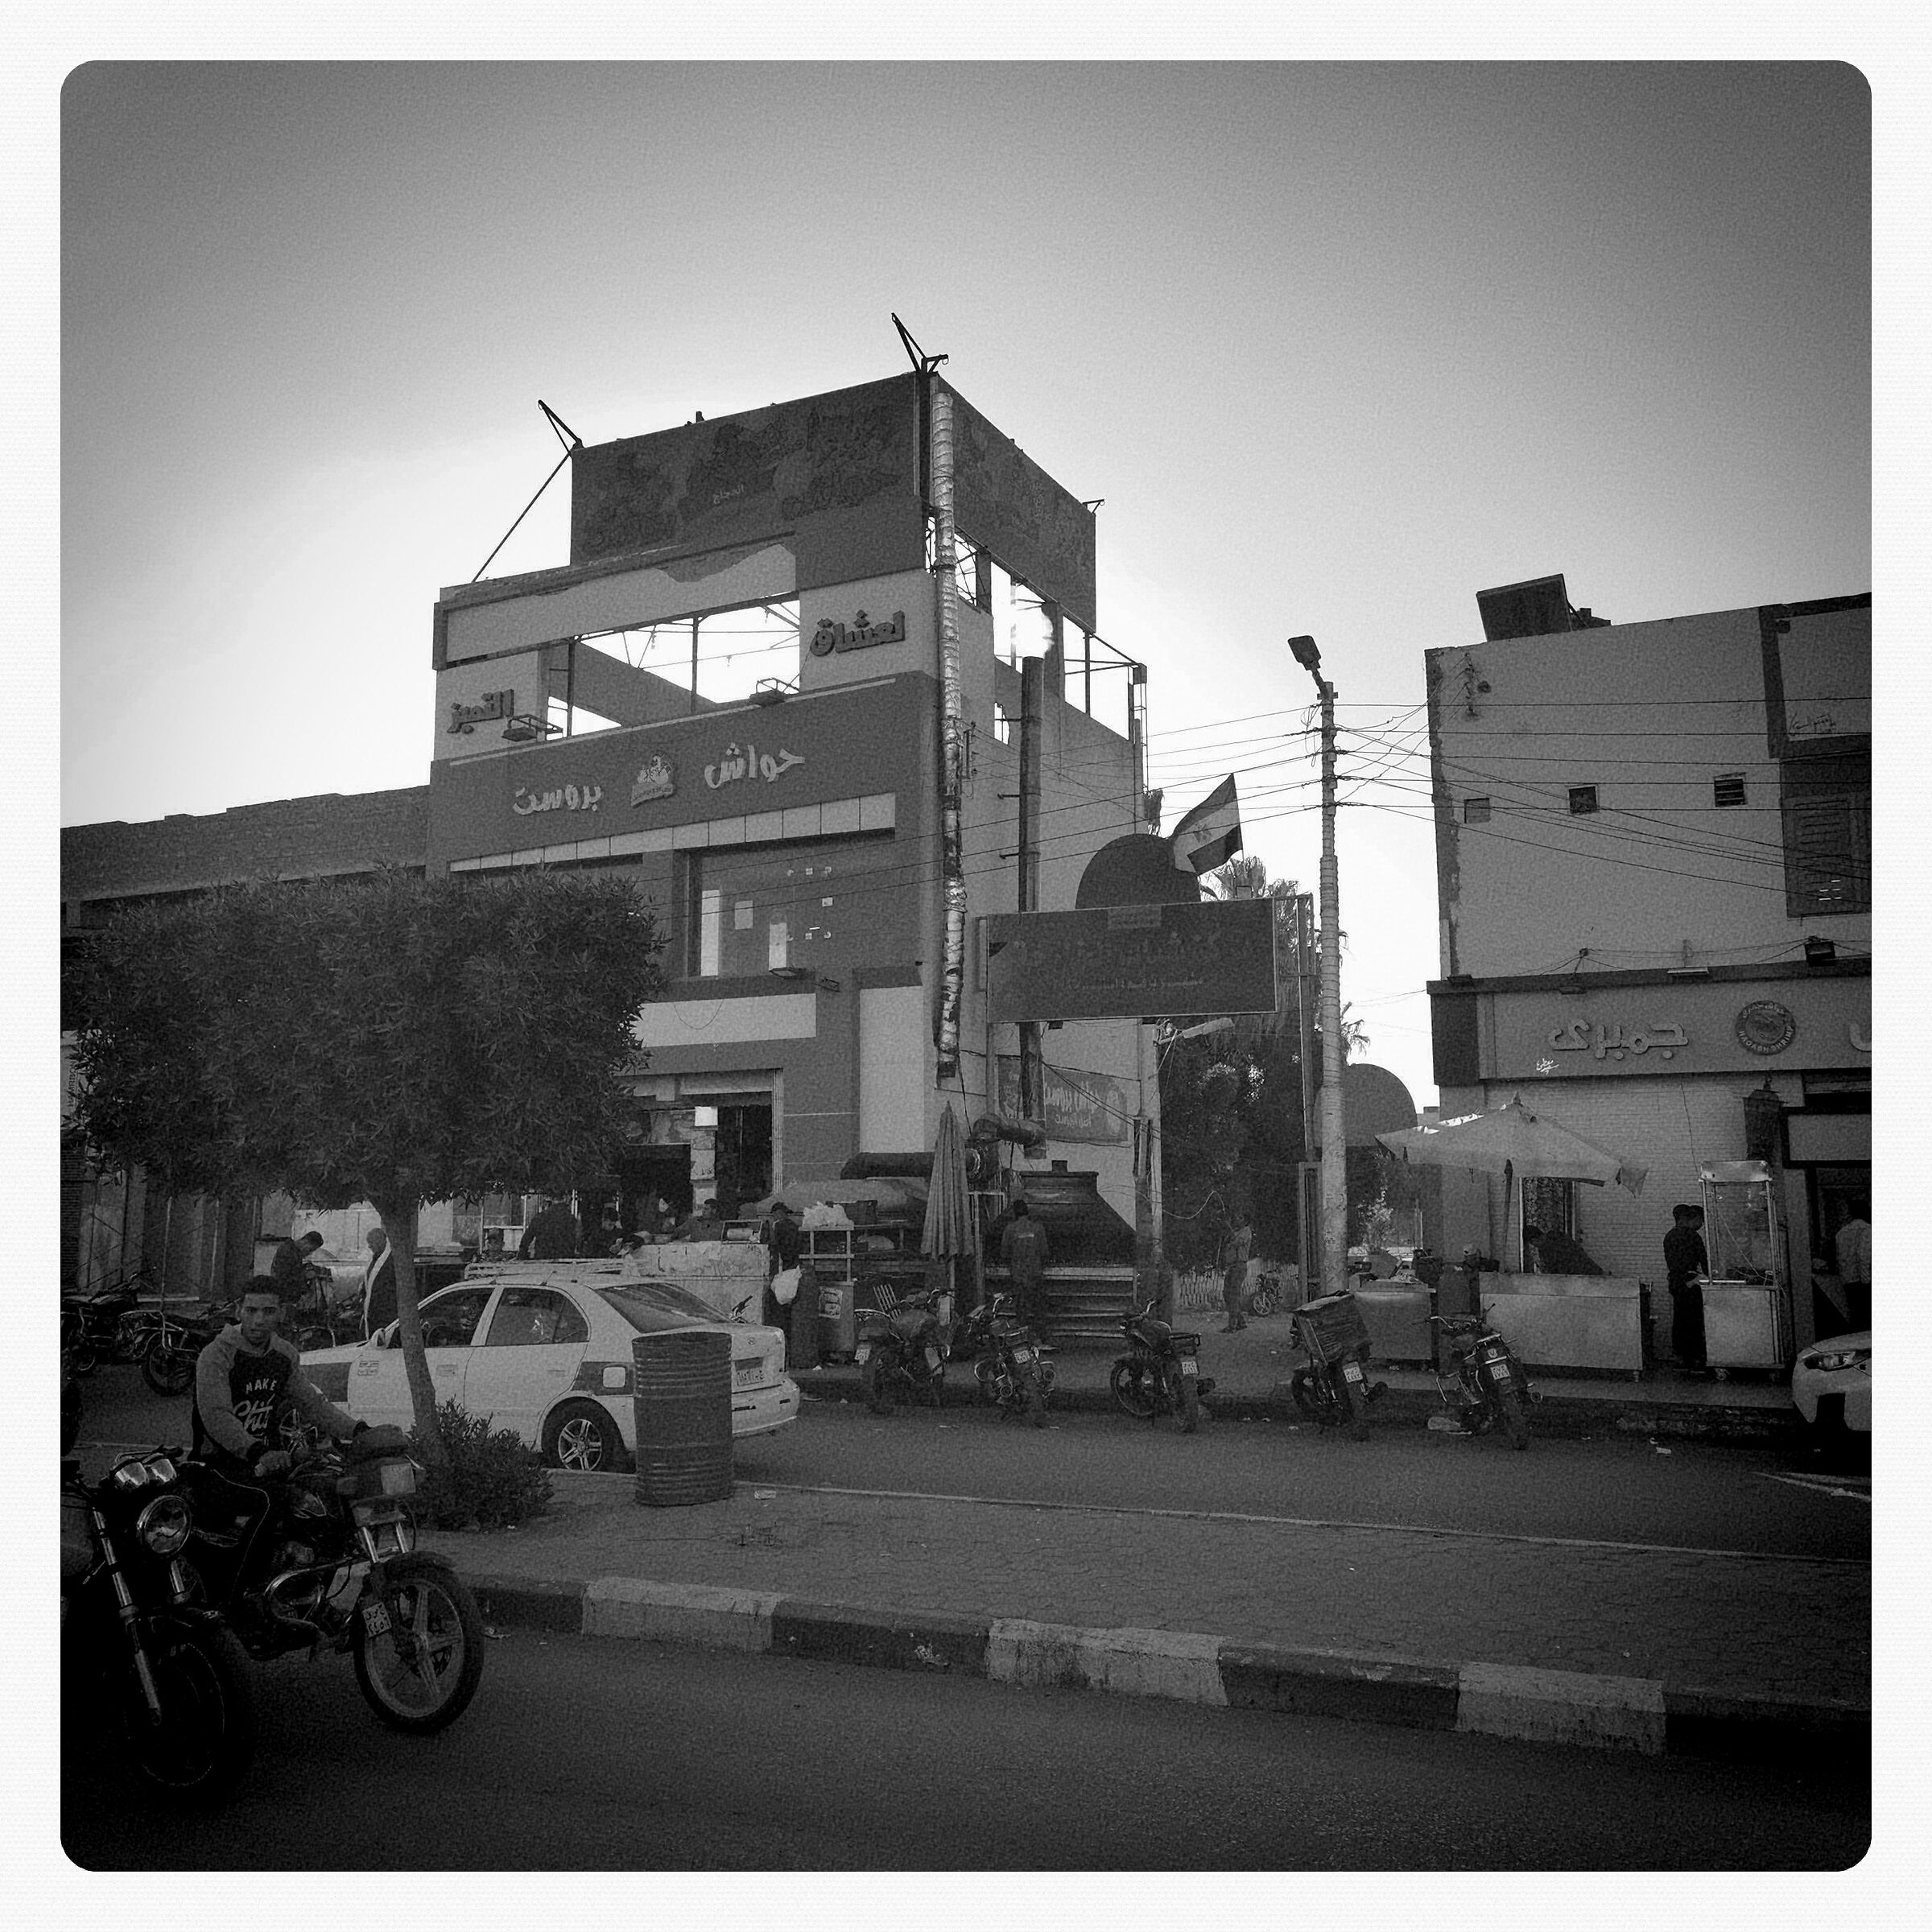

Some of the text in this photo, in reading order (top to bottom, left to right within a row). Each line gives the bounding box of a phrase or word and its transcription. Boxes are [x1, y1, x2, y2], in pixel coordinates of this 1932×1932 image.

[447, 609, 906, 734] لعشاق التميز
[704, 741, 806, 789] حواش
[512, 783, 603, 815] بروست
[246, 1377, 278, 1394] MAKE
